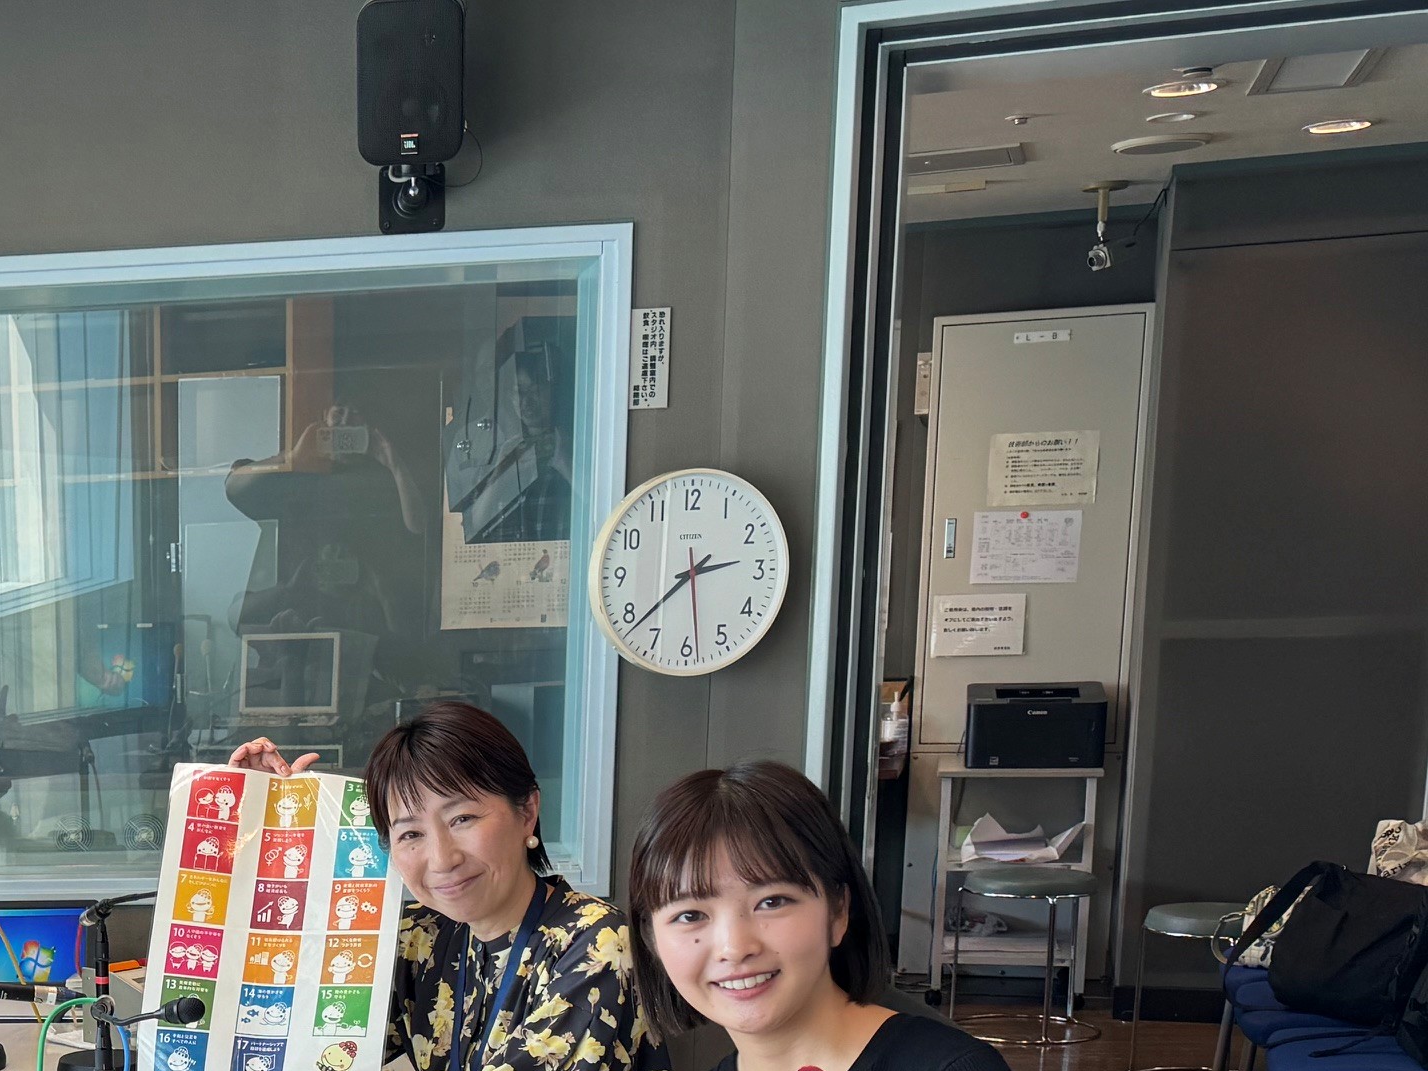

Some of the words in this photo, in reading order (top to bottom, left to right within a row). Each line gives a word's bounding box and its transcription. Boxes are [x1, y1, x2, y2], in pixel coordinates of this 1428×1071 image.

[684, 488, 702, 511] 12
[650, 500, 665, 522] 11
[724, 497, 728, 520] 1
[744, 523, 755, 545] 2
[624, 528, 640, 551] 10
[752, 559, 765, 580] 3
[614, 566, 627, 588] 9
[740, 596, 753, 618] 4
[622, 602, 636, 624] 8
[649, 628, 662, 650] 7
[715, 624, 728, 646] 5
[680, 636, 692, 658] 6
[271, 782, 278, 791] 2
[346, 784, 354, 792] 3
[188, 822, 195, 832] 4
[264, 832, 272, 842] 5
[340, 832, 347, 842] 6
[180, 874, 188, 883] 7
[257, 882, 265, 892] 8
[334, 884, 342, 893] 9
[173, 927, 185, 938] 10
[250, 936, 262, 946] 11
[328, 938, 340, 948] 12
[166, 979, 176, 989] 13
[244, 988, 256, 998] 14
[321, 990, 332, 1000] 15
[159, 1033, 170, 1043] 16
[236, 1040, 249, 1050] 17
